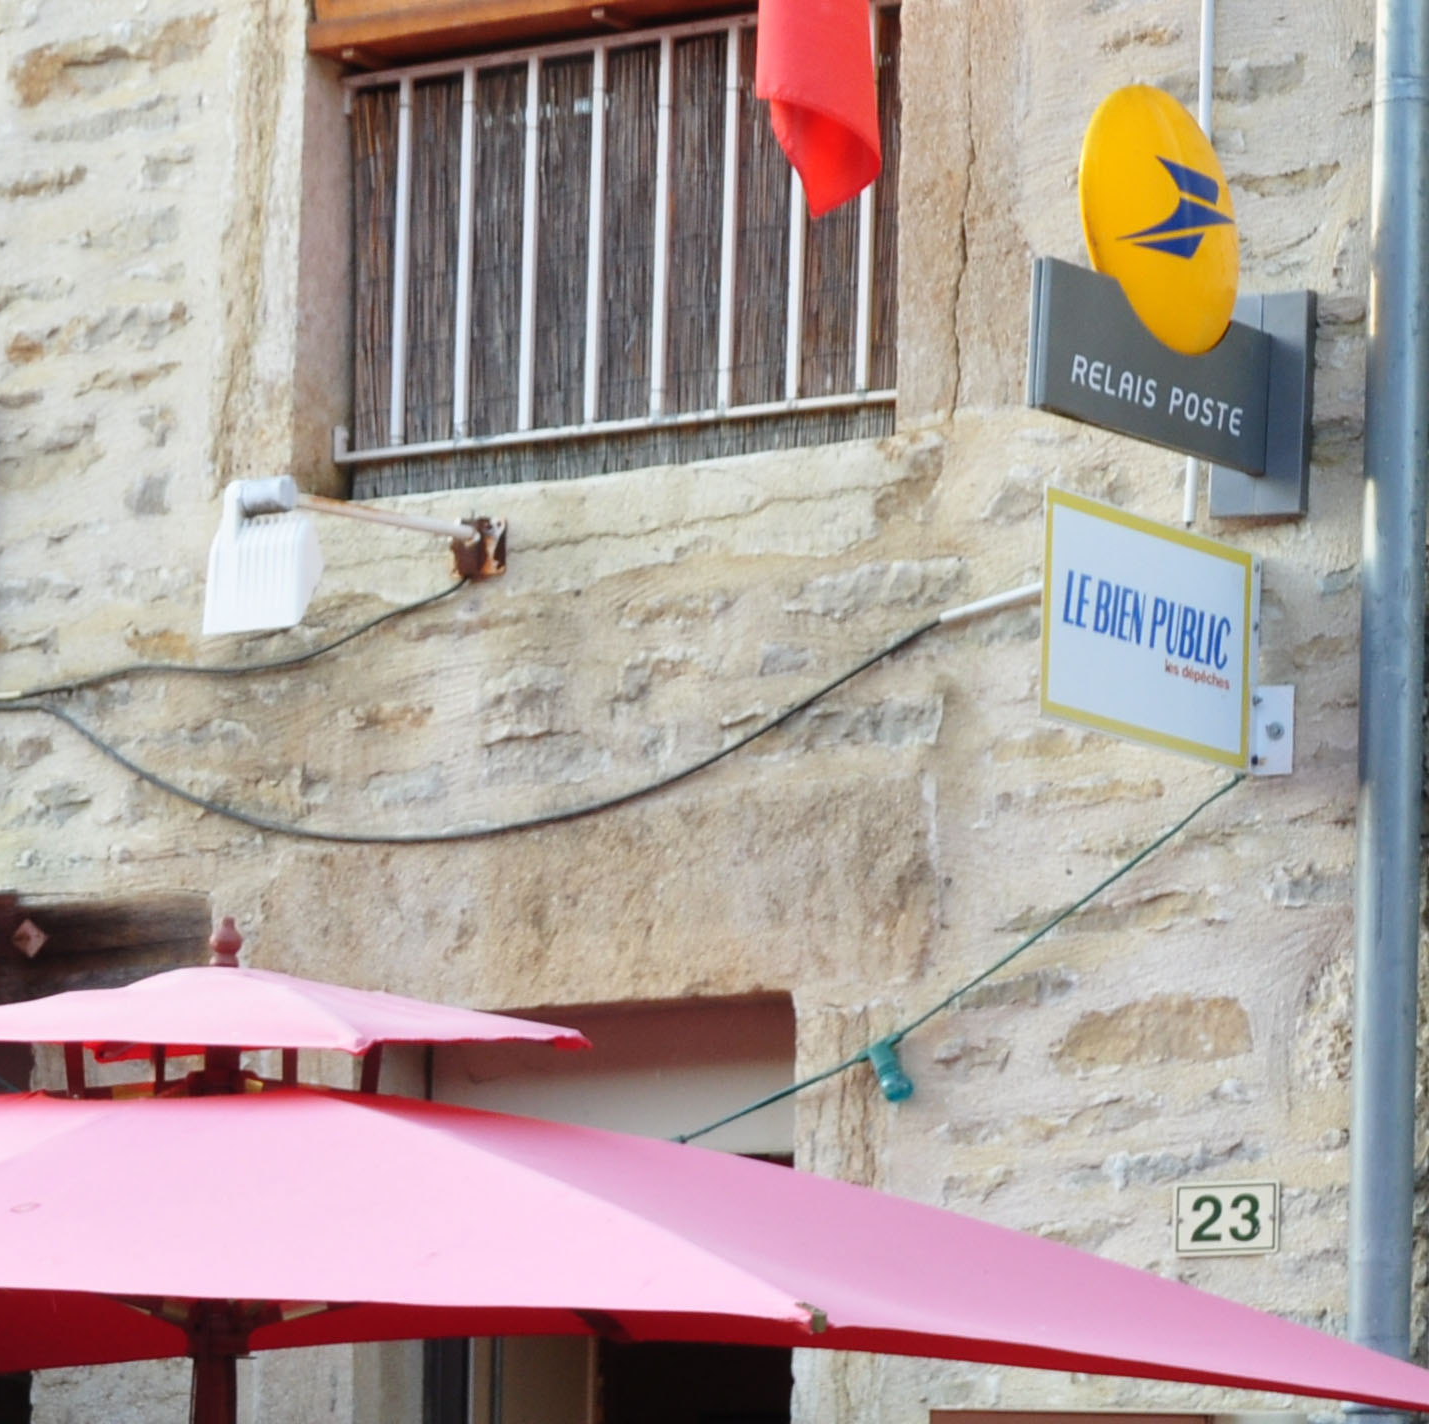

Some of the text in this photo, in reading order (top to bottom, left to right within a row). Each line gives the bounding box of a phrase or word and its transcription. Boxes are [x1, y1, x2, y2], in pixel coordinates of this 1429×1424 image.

[1070, 354, 1244, 438] RELAIS POSTE
[1061, 569, 1232, 671] LE BIEN PUBLIC
[1164, 658, 1231, 690] les dépêches
[1191, 1193, 1261, 1242] 23
